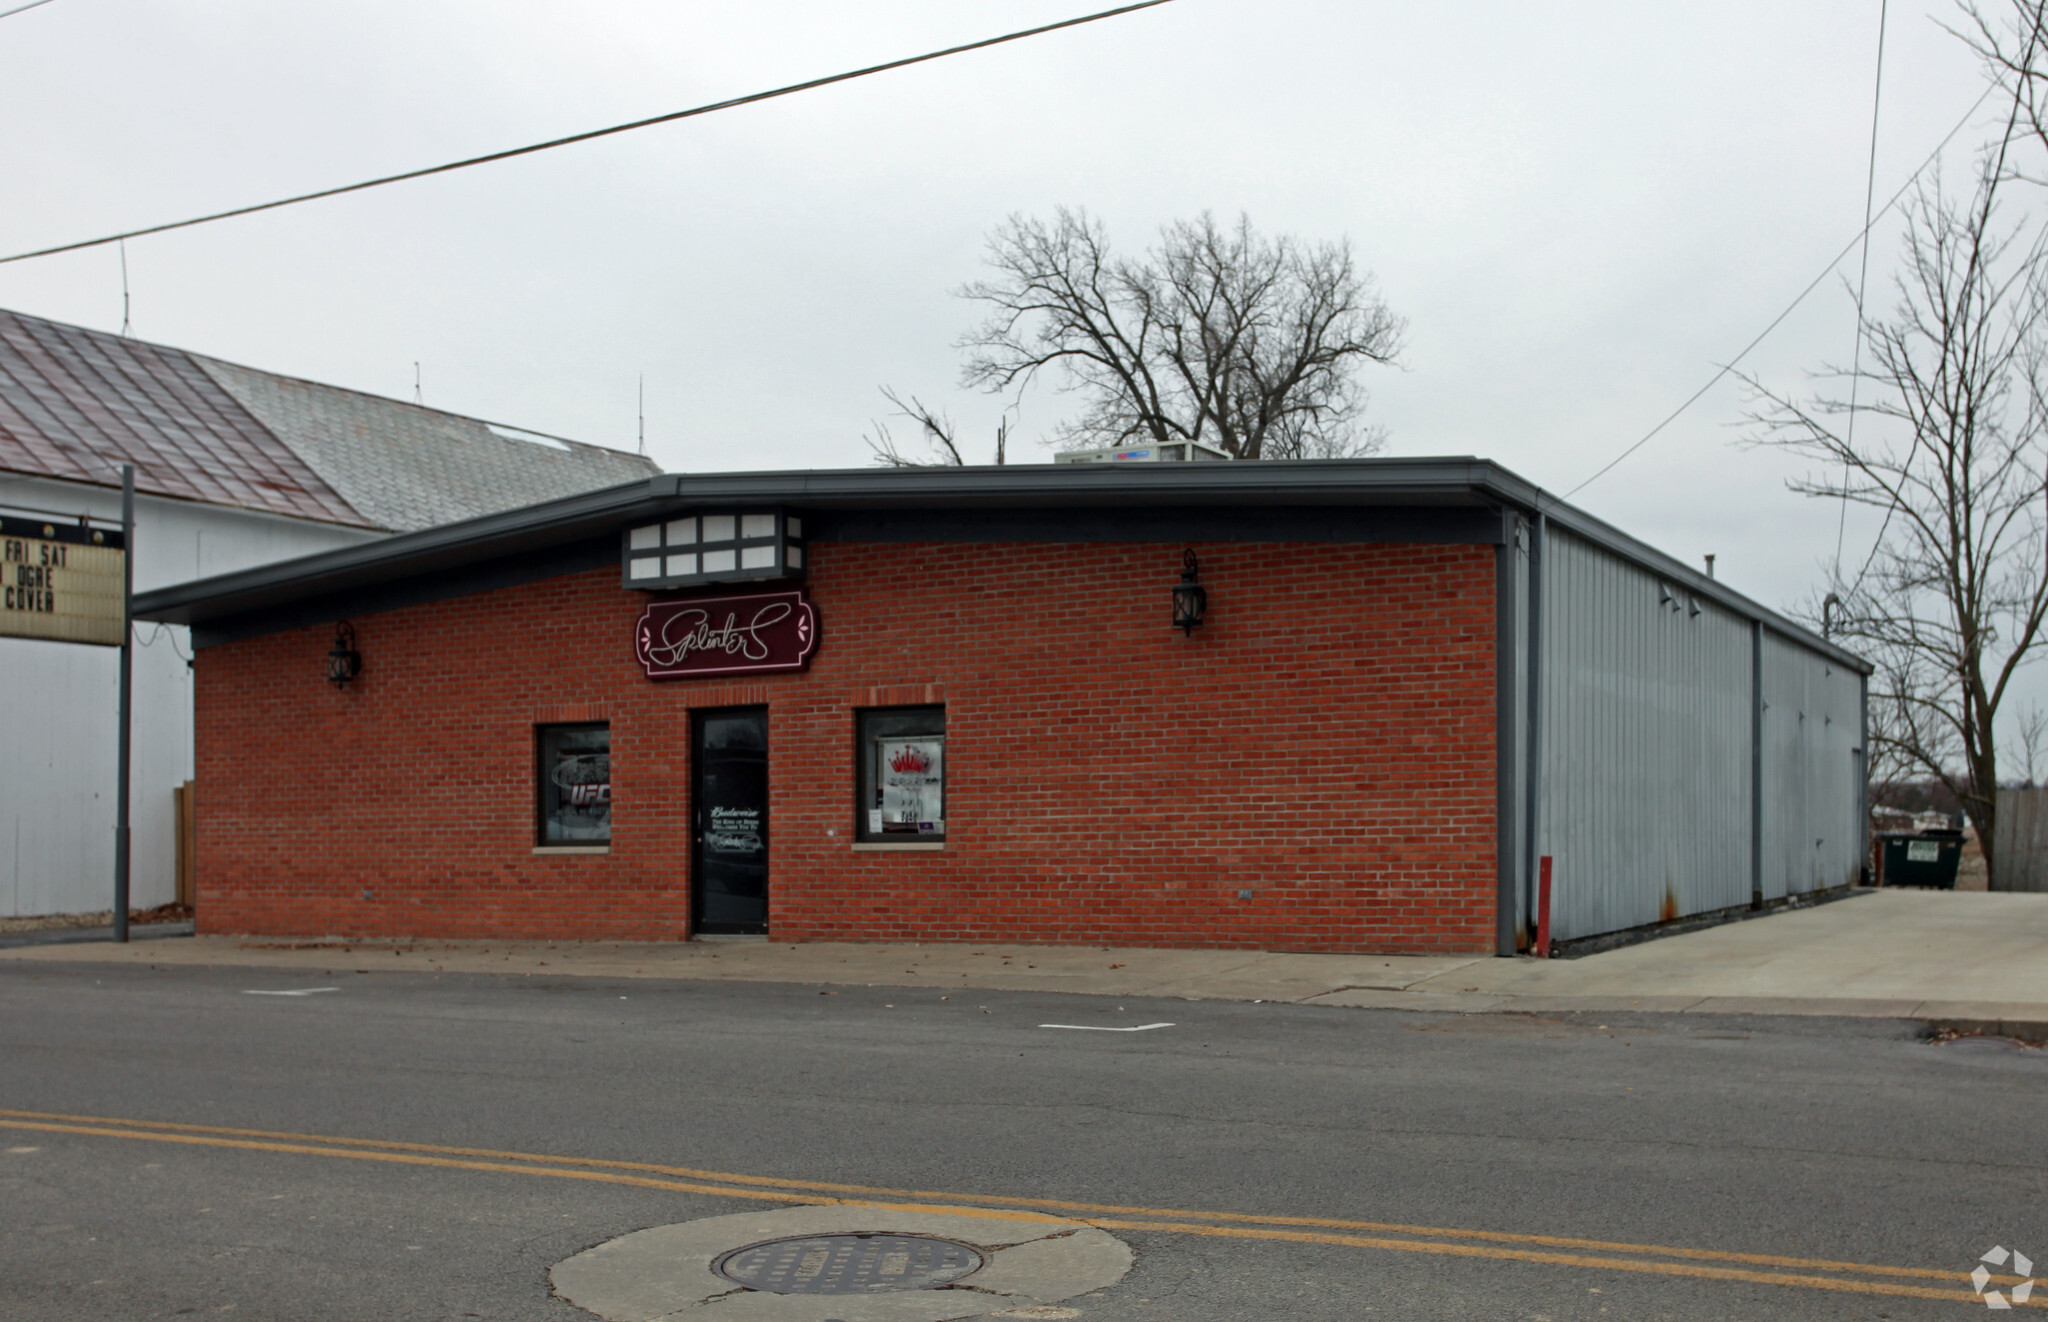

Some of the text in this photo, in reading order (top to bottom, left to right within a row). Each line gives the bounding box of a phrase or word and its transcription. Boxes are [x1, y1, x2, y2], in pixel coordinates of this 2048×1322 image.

[5, 539, 67, 568] FRI SAT
[17, 564, 53, 589] OGRE
[5, 585, 54, 613] COVER
[571, 784, 611, 806] UFC
